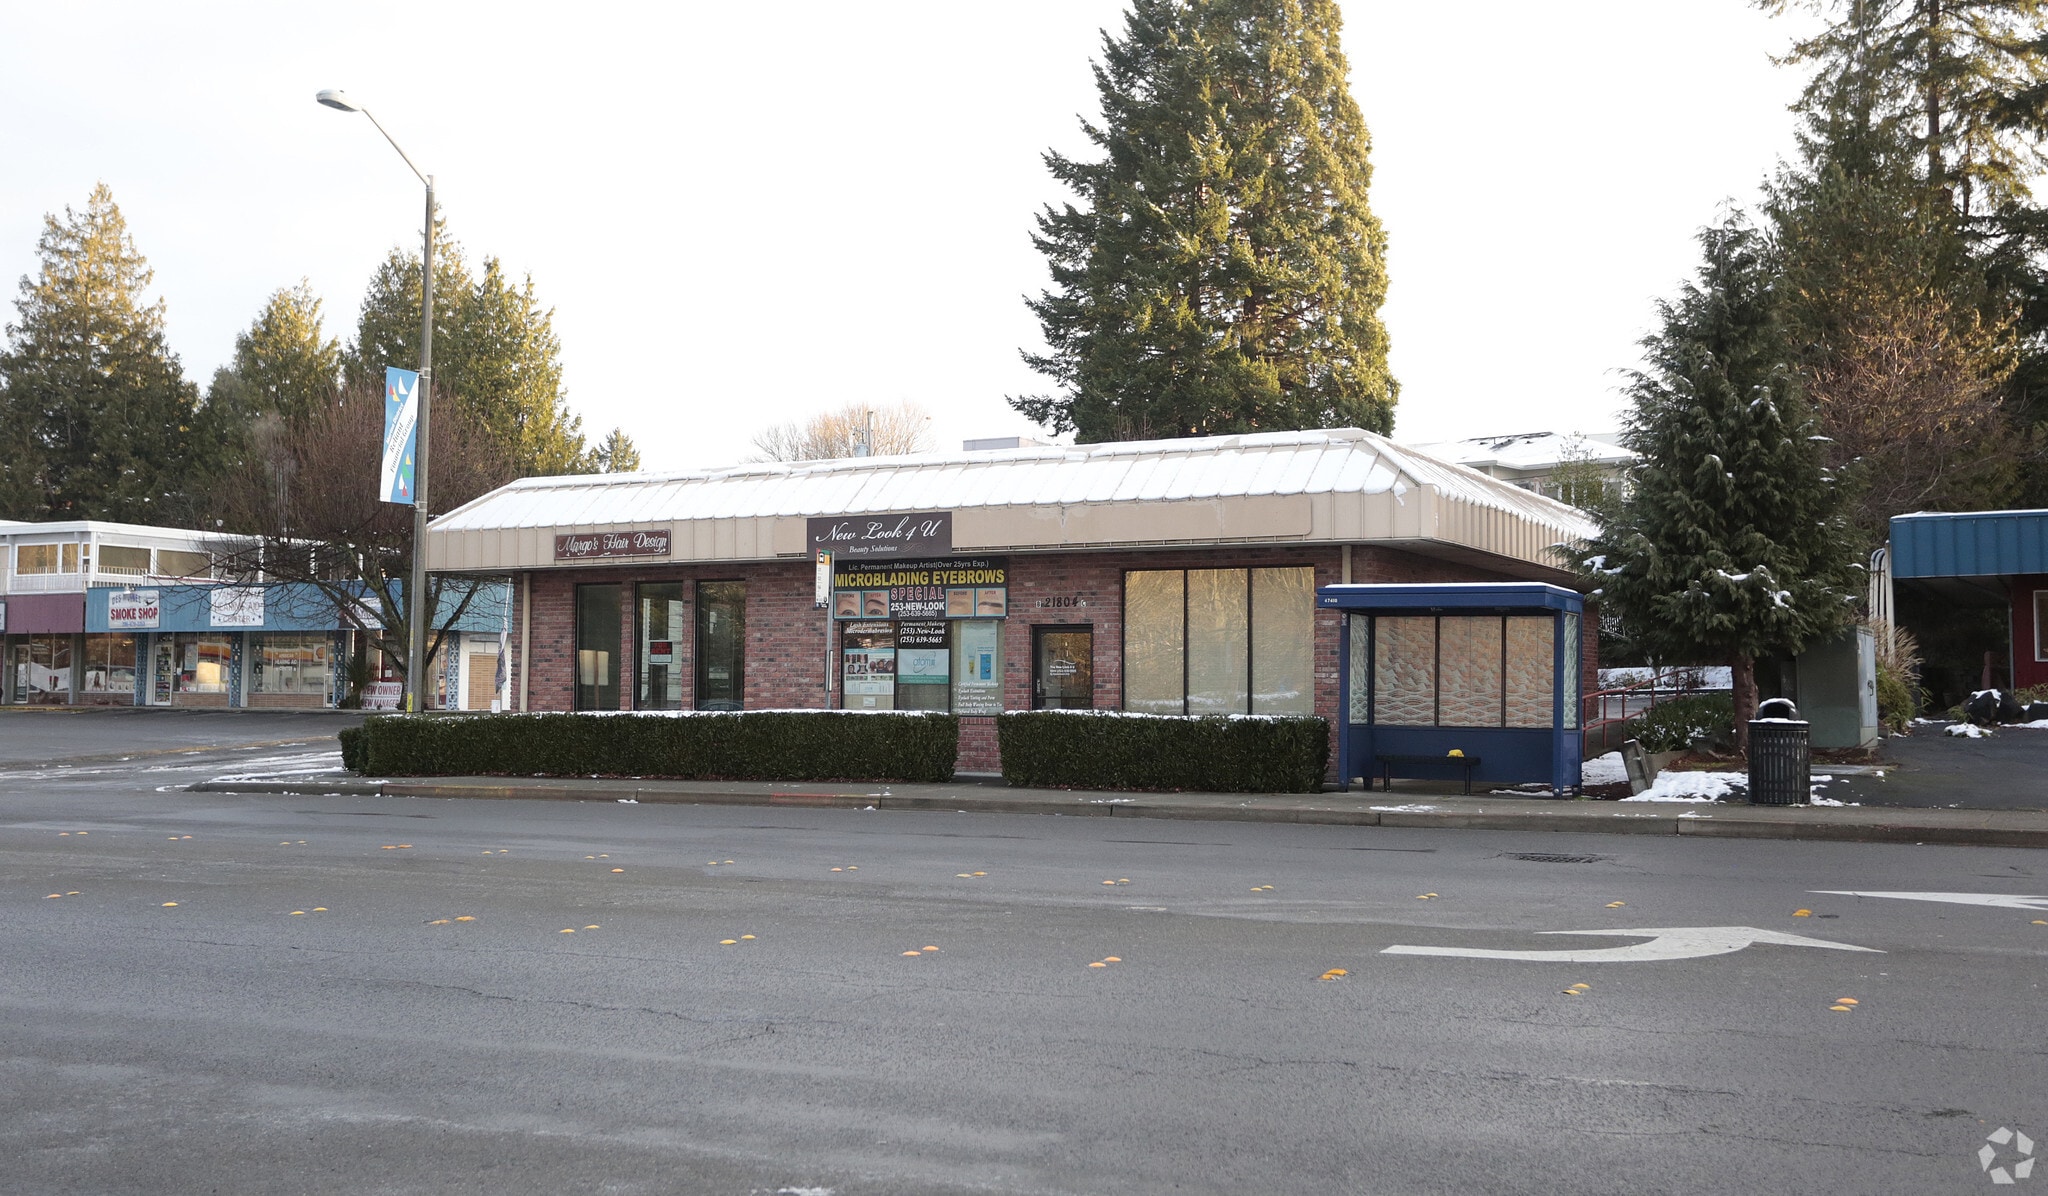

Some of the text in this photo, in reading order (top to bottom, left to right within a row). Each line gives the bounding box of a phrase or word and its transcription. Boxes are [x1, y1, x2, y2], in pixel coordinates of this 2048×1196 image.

[390, 422, 404, 452] Reliant
[390, 415, 414, 473] Financial Group
[816, 516, 942, 542] New Look 4 U
[558, 532, 667, 556] Margo's Hair Design
[849, 544, 898, 554] Beauty Solutions
[860, 562, 892, 570] Permanent
[894, 562, 918, 570] Makeup
[954, 560, 971, 569] 25yrs
[972, 560, 990, 568] Exp.)
[834, 571, 929, 588] MICROBLADING
[932, 569, 1005, 585] EYEBROWS
[890, 586, 944, 601] SPECIAL
[890, 602, 945, 611] 253-NEW-LOOK
[1045, 596, 1079, 607] 21804
[110, 607, 158, 620] SMOKE SHOP
[900, 636, 915, 644] (253)
[378, 685, 400, 695] OWNER
[362, 698, 374, 707] EW
